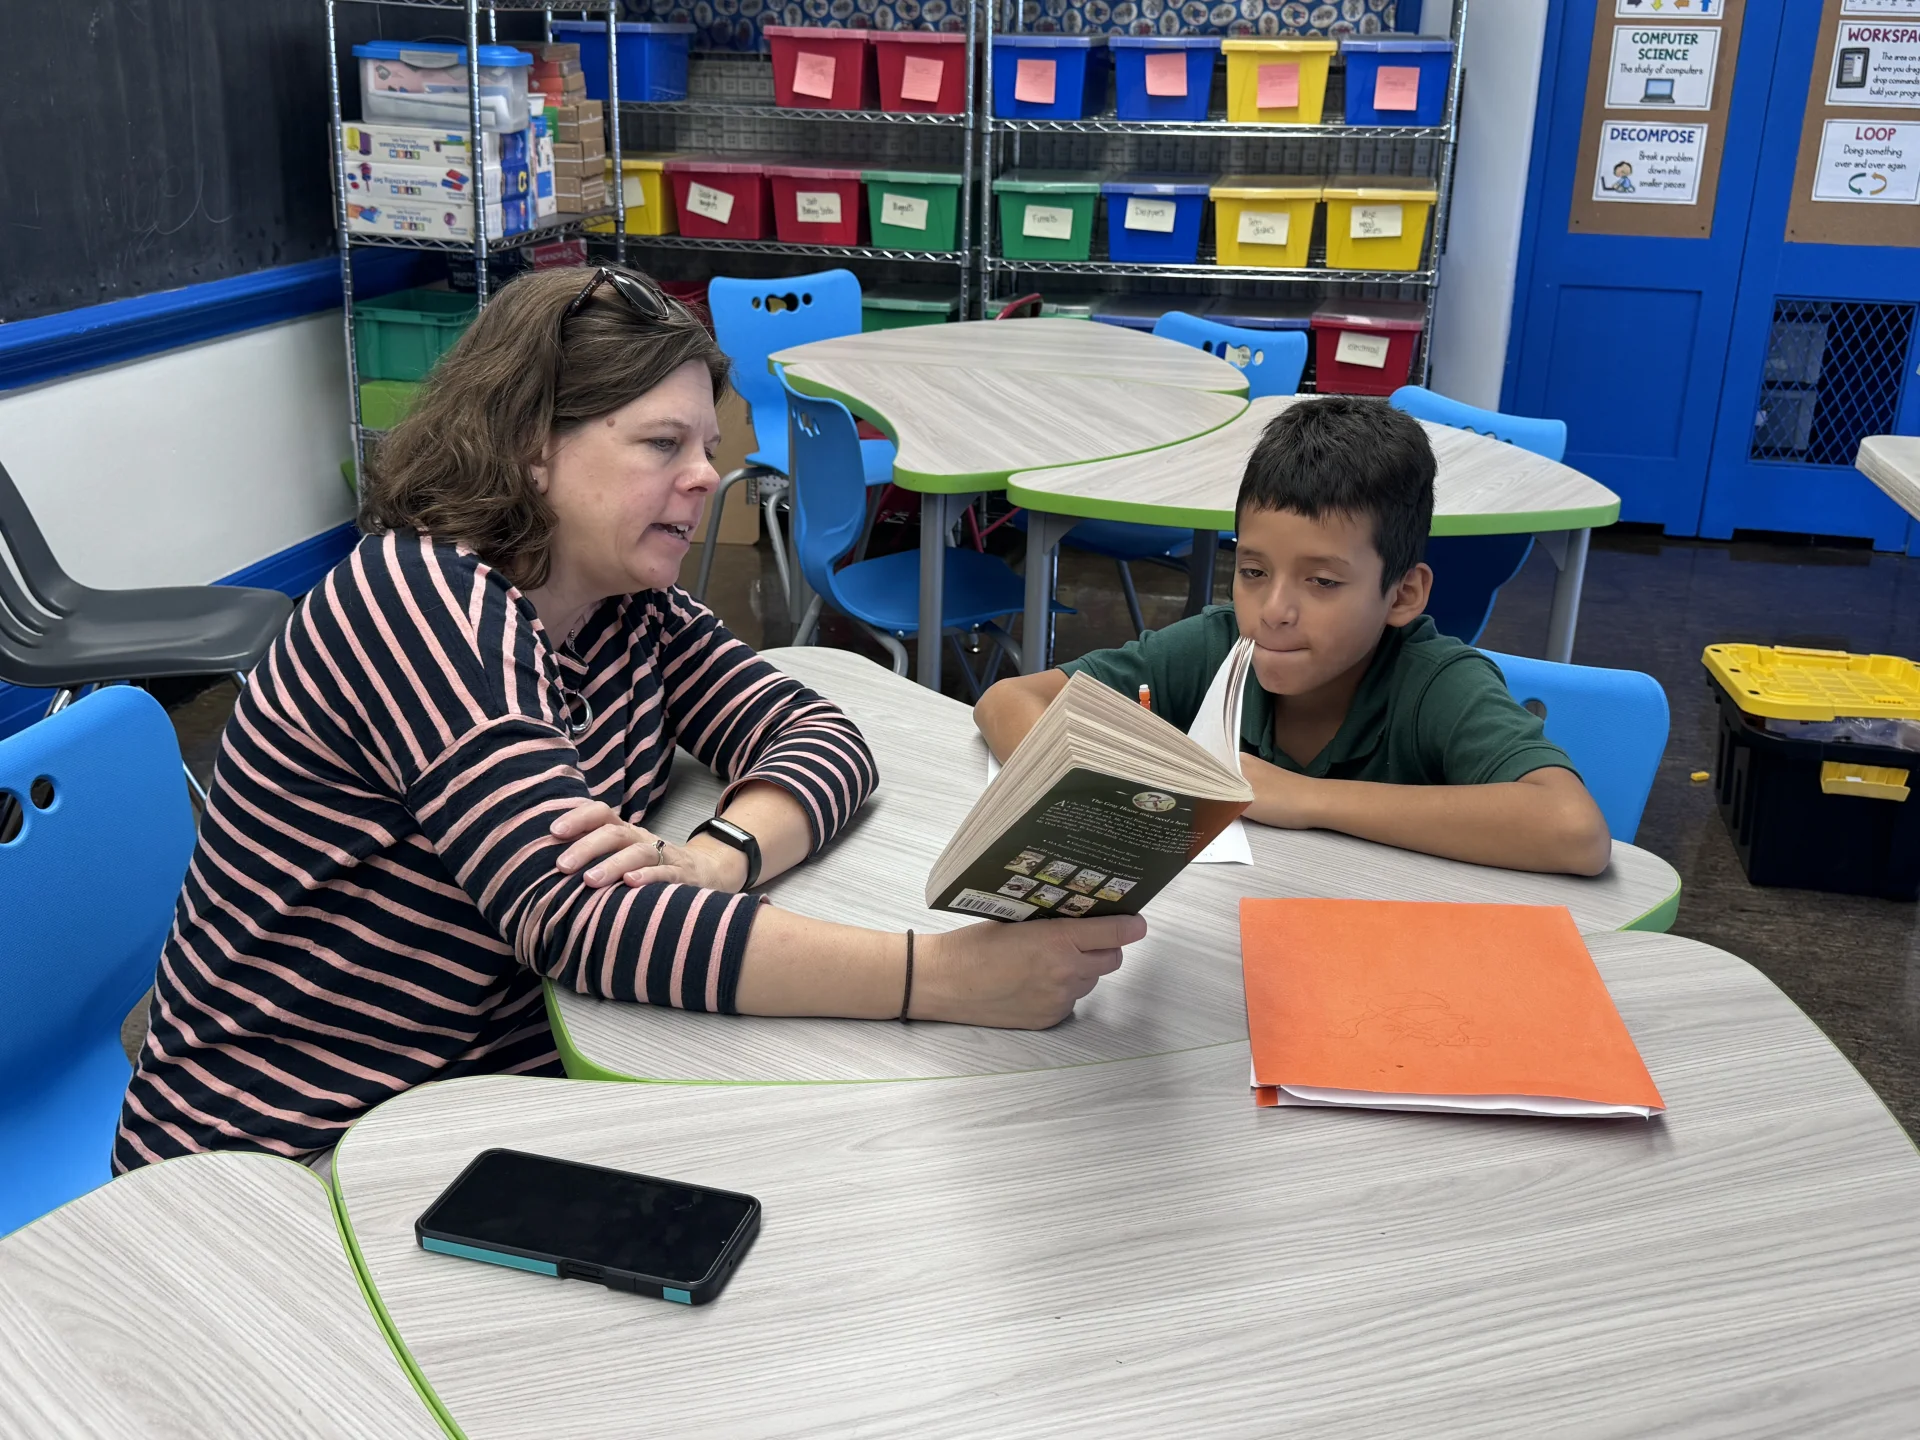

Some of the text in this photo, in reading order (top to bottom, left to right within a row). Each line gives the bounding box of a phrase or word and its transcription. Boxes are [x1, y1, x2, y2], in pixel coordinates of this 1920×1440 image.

[1631, 32, 1699, 45] COMPUTER
[1638, 48, 1690, 61] SCIENCE
[1882, 51, 1894, 61] The
[1620, 63, 1704, 77] The study of computers
[1873, 62, 1892, 73] where
[1893, 67, 1905, 75] you
[1873, 75, 1920, 86] drop commands
[1869, 86, 1884, 96] build
[1884, 89, 1899, 98] your
[1610, 128, 1696, 143] DECOMPOSE
[1855, 126, 1897, 141] LOOP
[1639, 150, 1658, 161] Break
[1665, 152, 1694, 164] problem
[1843, 144, 1903, 158] Doing something
[1648, 164, 1682, 176] down into
[1854, 158, 1867, 169] and
[1868, 162, 1886, 170] over
[1887, 164, 1907, 173] again
[1639, 178, 1686, 190] smaller pieces
[1103, 801, 1118, 809] Gray
[1119, 805, 1140, 815] House
[1154, 816, 1171, 824] need
[1096, 865, 1113, 874] Poppy
